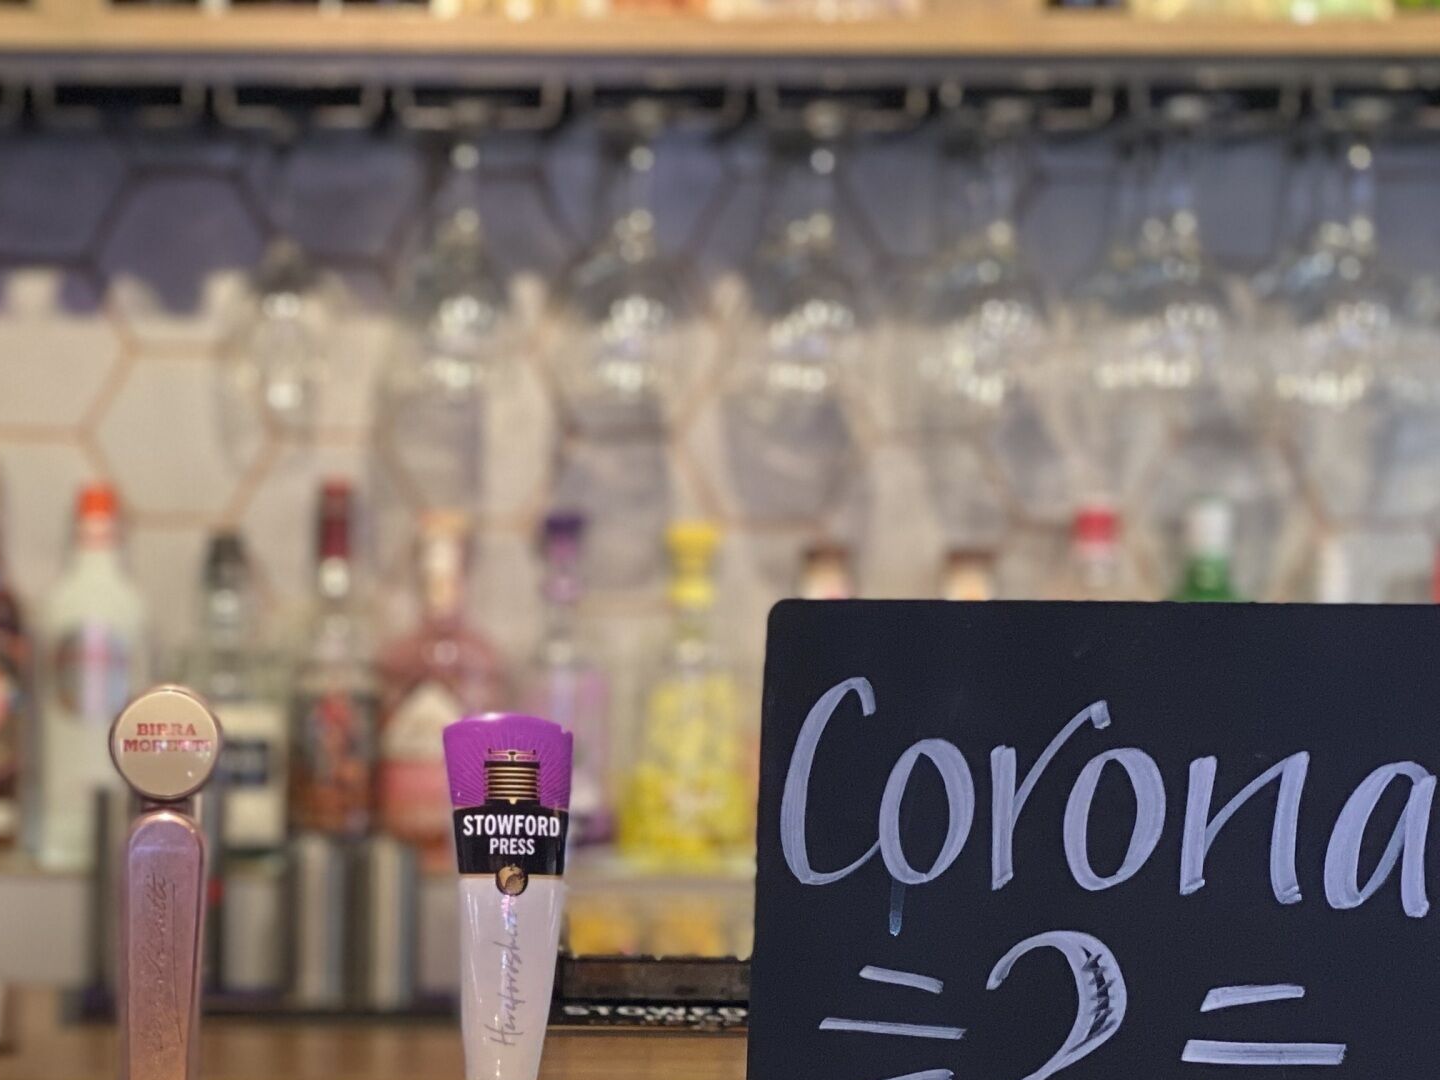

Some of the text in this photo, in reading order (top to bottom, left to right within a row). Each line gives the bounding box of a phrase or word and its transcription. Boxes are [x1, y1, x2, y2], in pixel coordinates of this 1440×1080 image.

[779, 676, 1437, 919] Corona
[462, 814, 560, 838] STOWFORD
[489, 837, 536, 856] PRESS
